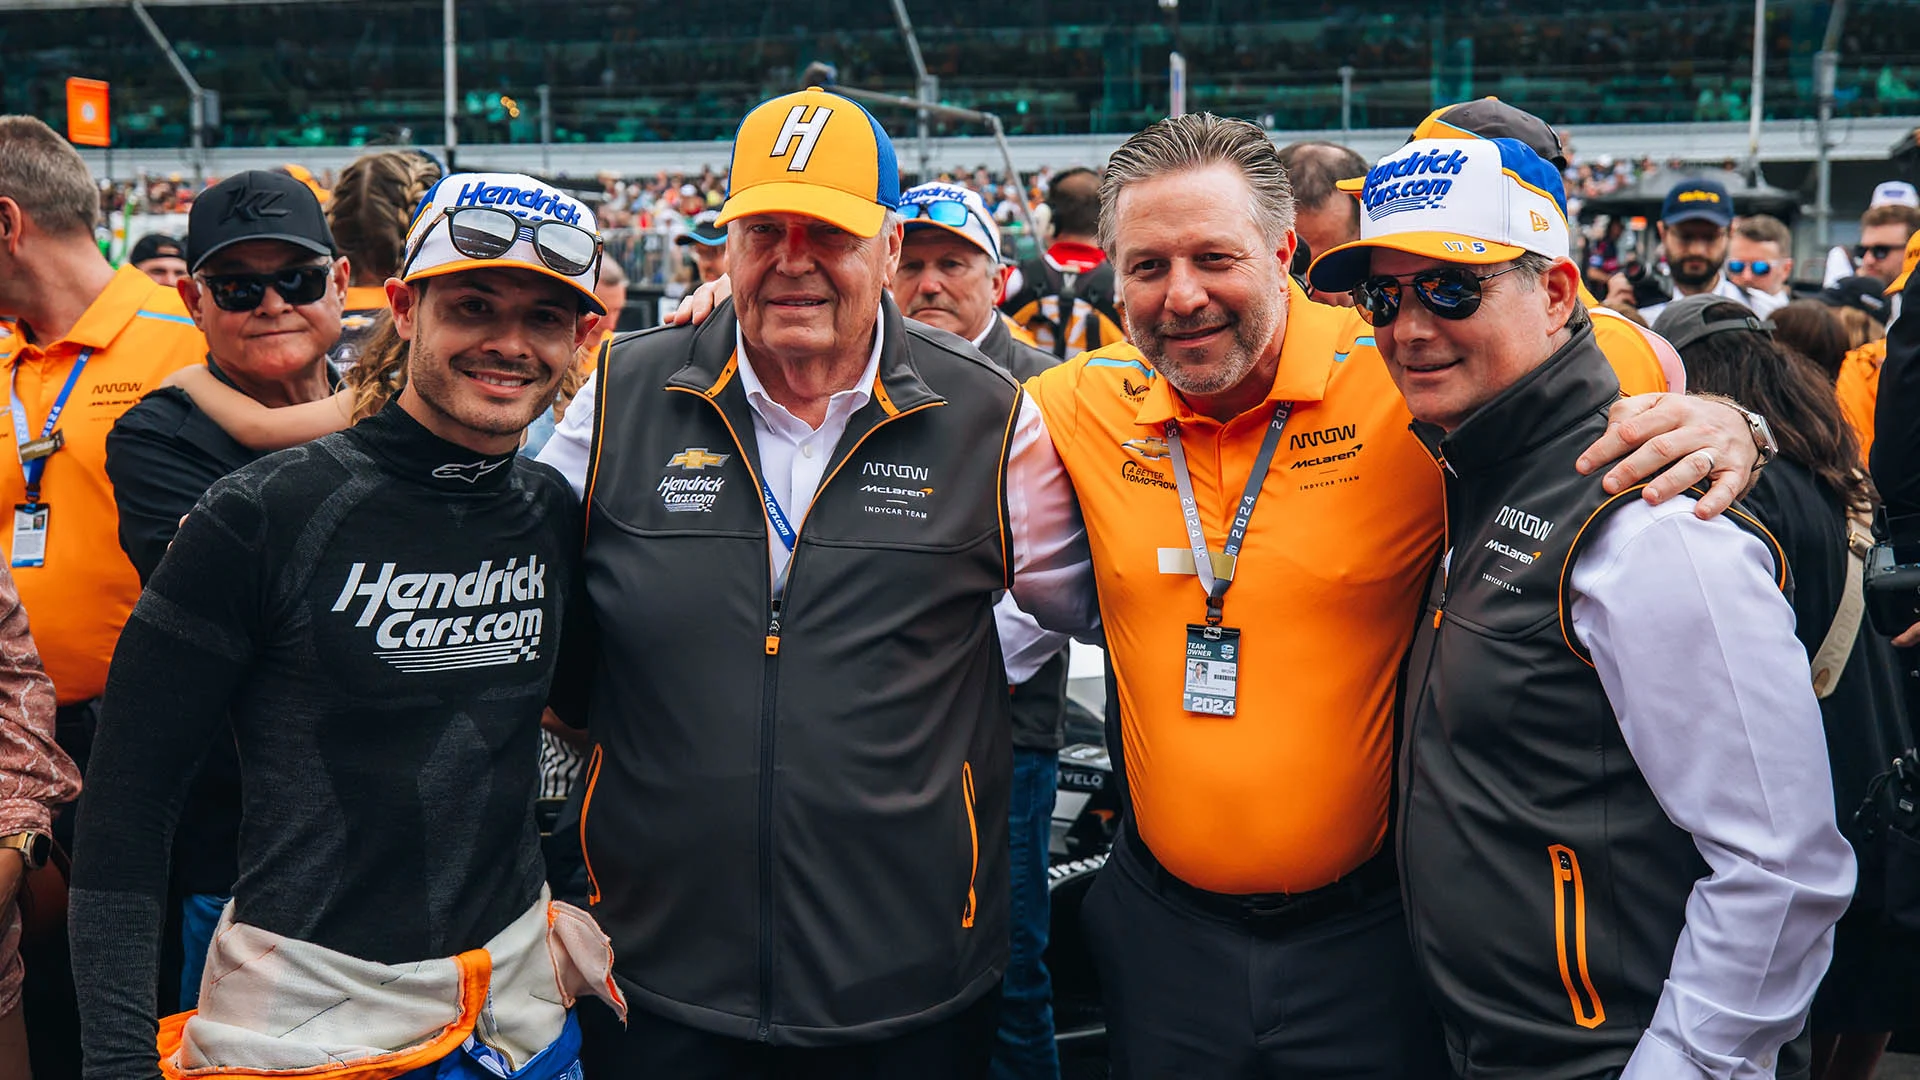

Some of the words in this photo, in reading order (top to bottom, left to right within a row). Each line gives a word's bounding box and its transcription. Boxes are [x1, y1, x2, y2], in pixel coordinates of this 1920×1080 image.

[769, 105, 834, 172] H
[456, 182, 581, 226] Hendrick
[1289, 423, 1356, 451] ARROW
[1290, 450, 1357, 470] McLaren
[862, 462, 929, 481] ARROW
[1128, 466, 1135, 474] A
[1135, 467, 1165, 479] BETTER
[656, 475, 725, 497] Hendrick
[860, 485, 926, 498] McLaren
[1126, 473, 1178, 491] TOMORROW
[1300, 480, 1335, 491] INDYCAR
[1338, 475, 1360, 483] TEAM
[664, 491, 717, 504] Cars.com
[864, 505, 902, 515] INDYCAR
[905, 509, 927, 519] TEAM
[1182, 496, 1201, 538] 2024
[1231, 495, 1255, 539] 2024
[1494, 505, 1555, 542] ARROW
[1484, 539, 1534, 565] McLaren
[331, 554, 545, 628] Hendrick
[1502, 582, 1522, 595] TEAM
[375, 607, 543, 649] Cars.com
[1187, 649, 1212, 657] OWNER
[1192, 696, 1235, 715] 2024
[1064, 772, 1103, 787] VELO
